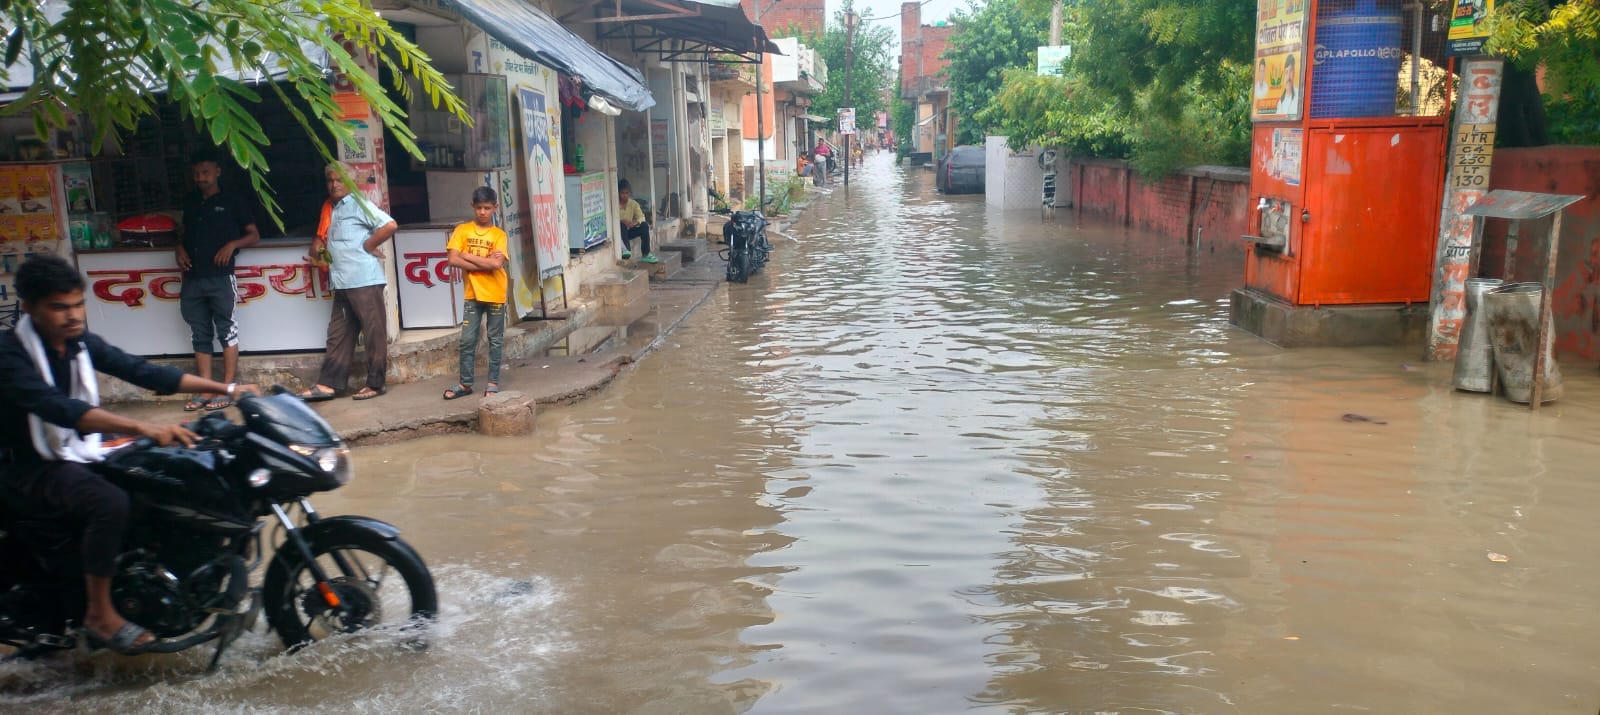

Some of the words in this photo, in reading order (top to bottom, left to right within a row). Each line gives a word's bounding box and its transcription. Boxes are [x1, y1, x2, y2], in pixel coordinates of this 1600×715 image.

[1316, 50, 1334, 58] APL
[1335, 48, 1376, 57] APOLLO
[1461, 133, 1488, 143] JTR
[1463, 166, 1480, 174] LT
[1455, 175, 1484, 187] 130
